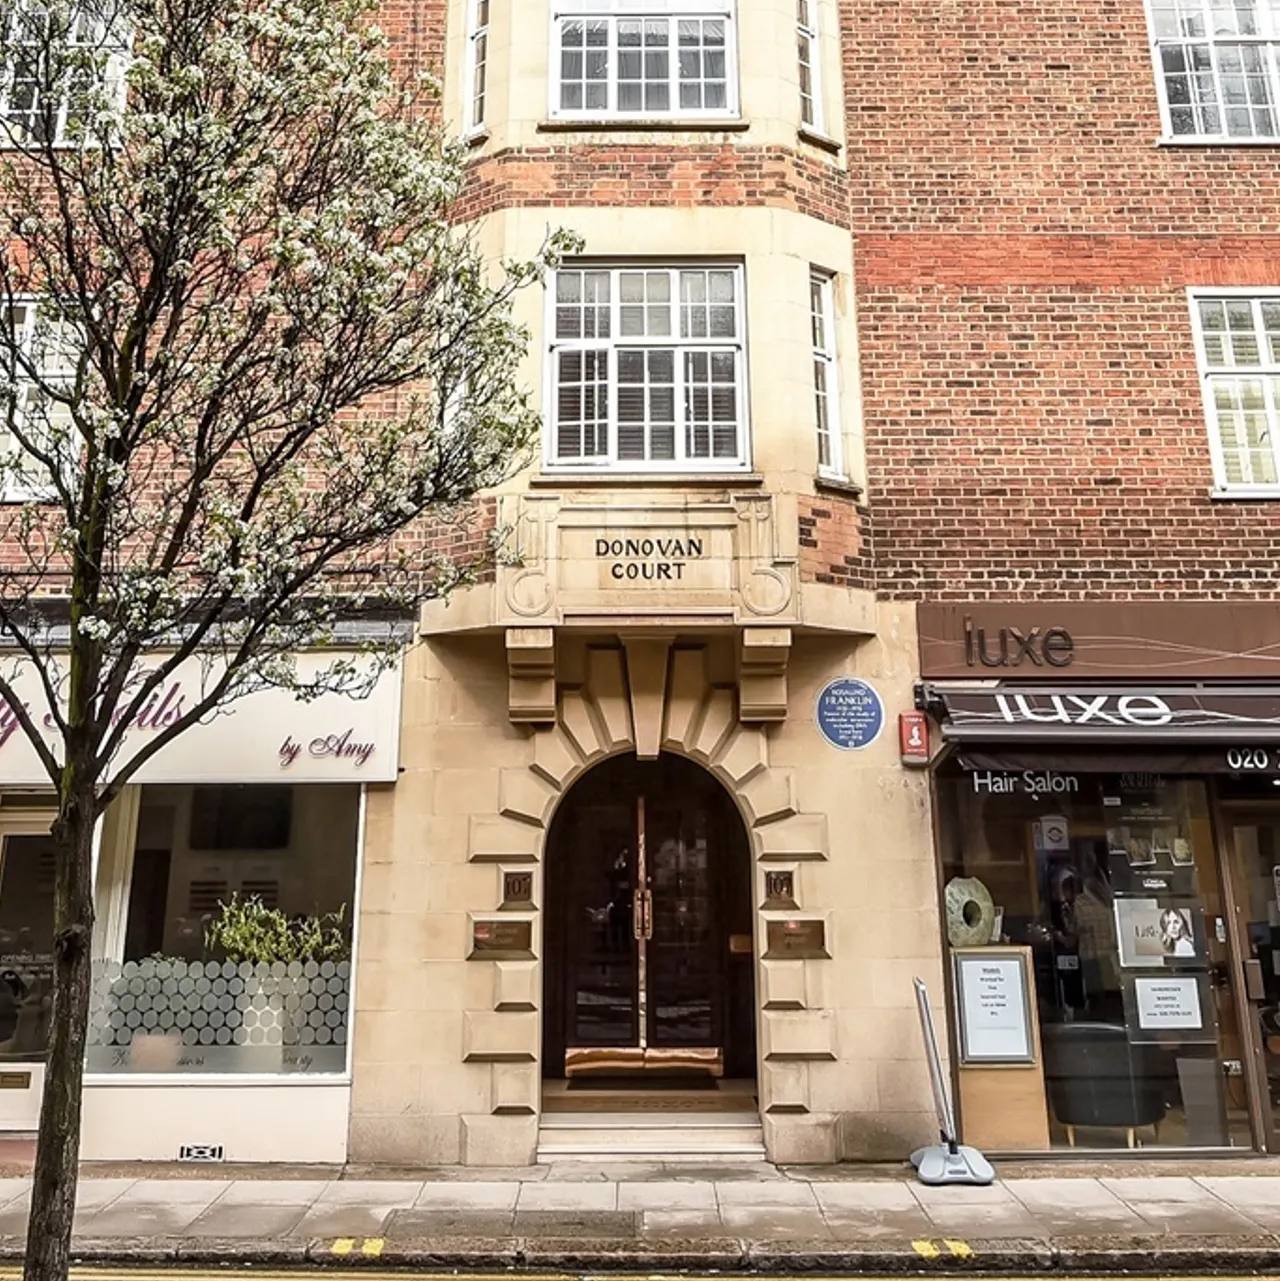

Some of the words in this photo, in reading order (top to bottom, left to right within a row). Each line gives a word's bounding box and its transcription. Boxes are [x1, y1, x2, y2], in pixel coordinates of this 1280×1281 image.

[595, 538, 703, 557] DONOVAN
[611, 562, 686, 580] COURT
[962, 614, 1075, 668] luxe
[825, 696, 872, 705] FRANKLIN
[278, 735, 303, 767] by
[308, 727, 376, 765] Amy
[1227, 748, 1268, 770] 020
[973, 771, 1018, 793] Hair
[1023, 770, 1079, 793] Salon
